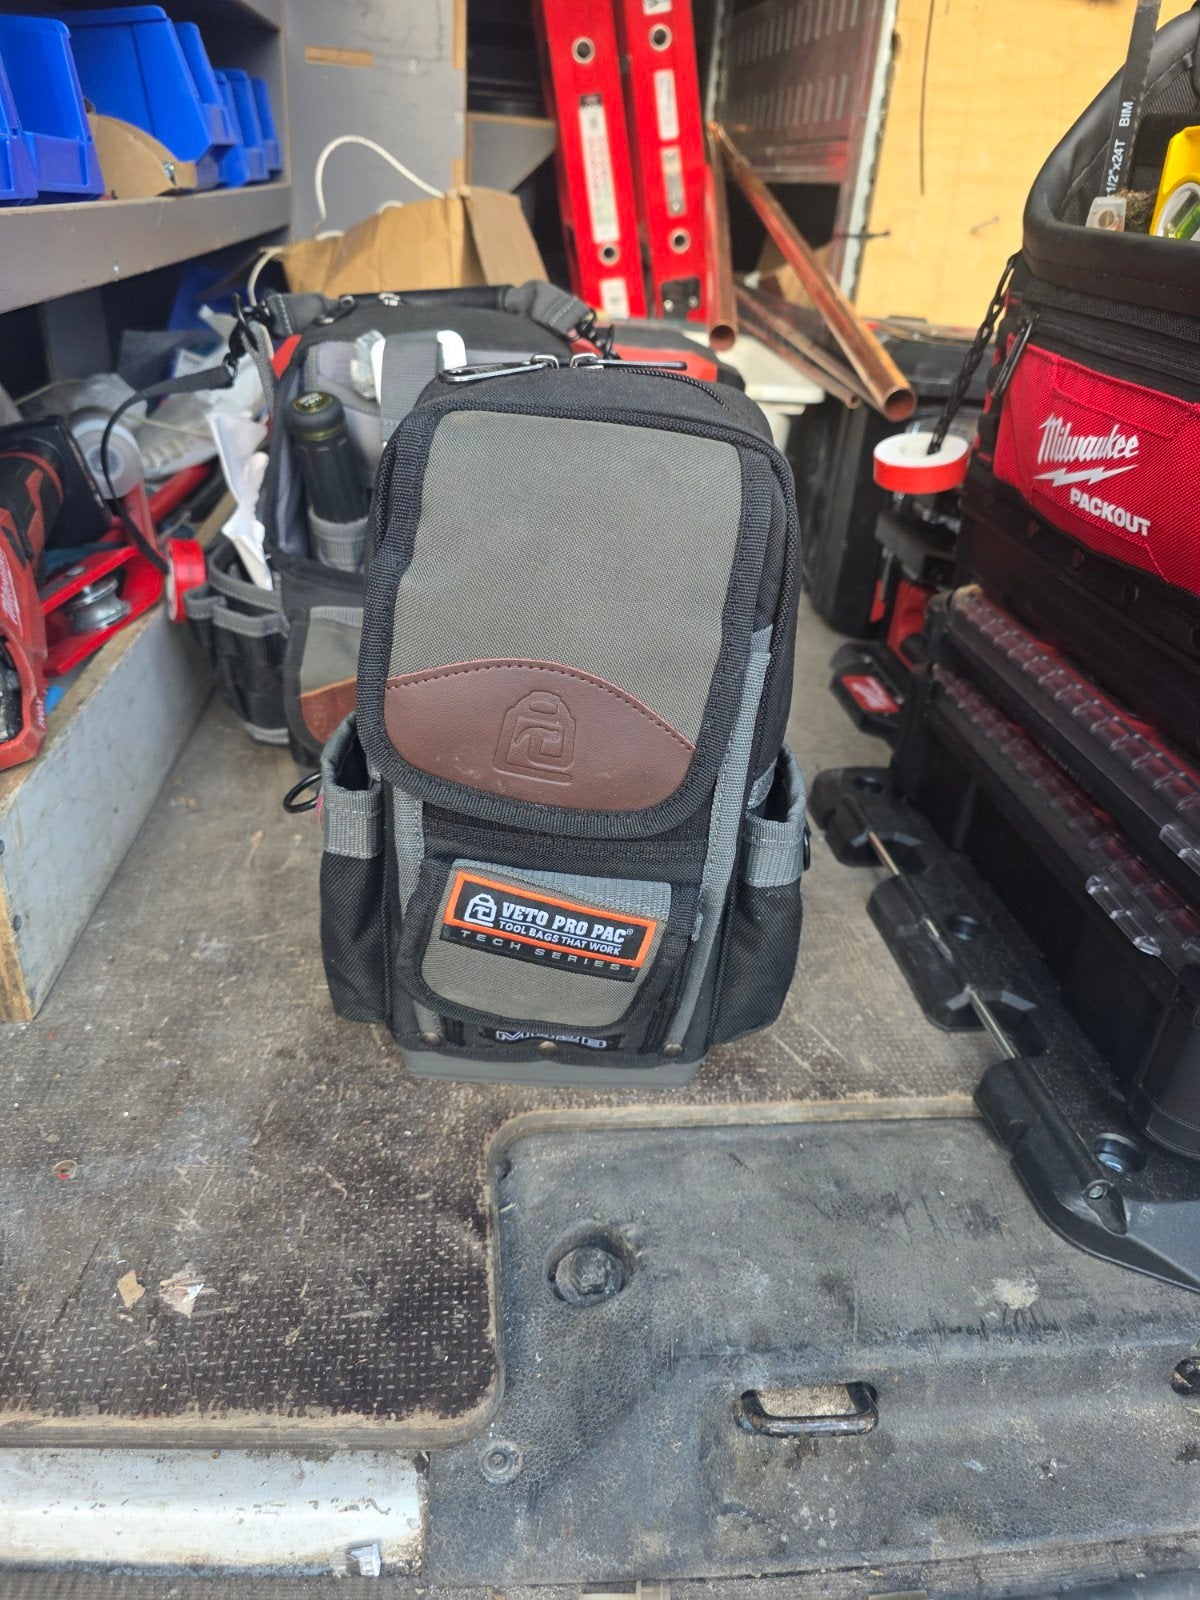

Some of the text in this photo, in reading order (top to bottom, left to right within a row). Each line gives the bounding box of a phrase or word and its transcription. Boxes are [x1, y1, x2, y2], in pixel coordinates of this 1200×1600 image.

[1119, 101, 1134, 127] BIM
[1038, 412, 1140, 465] Milwaukee
[1070, 488, 1151, 536] PACKOUT
[502, 902, 550, 926] VETO
[552, 915, 589, 936] PRO
[461, 930, 621, 971] TECH SERIES
[500, 921, 622, 955] TOOL BAGS THAT WORK
